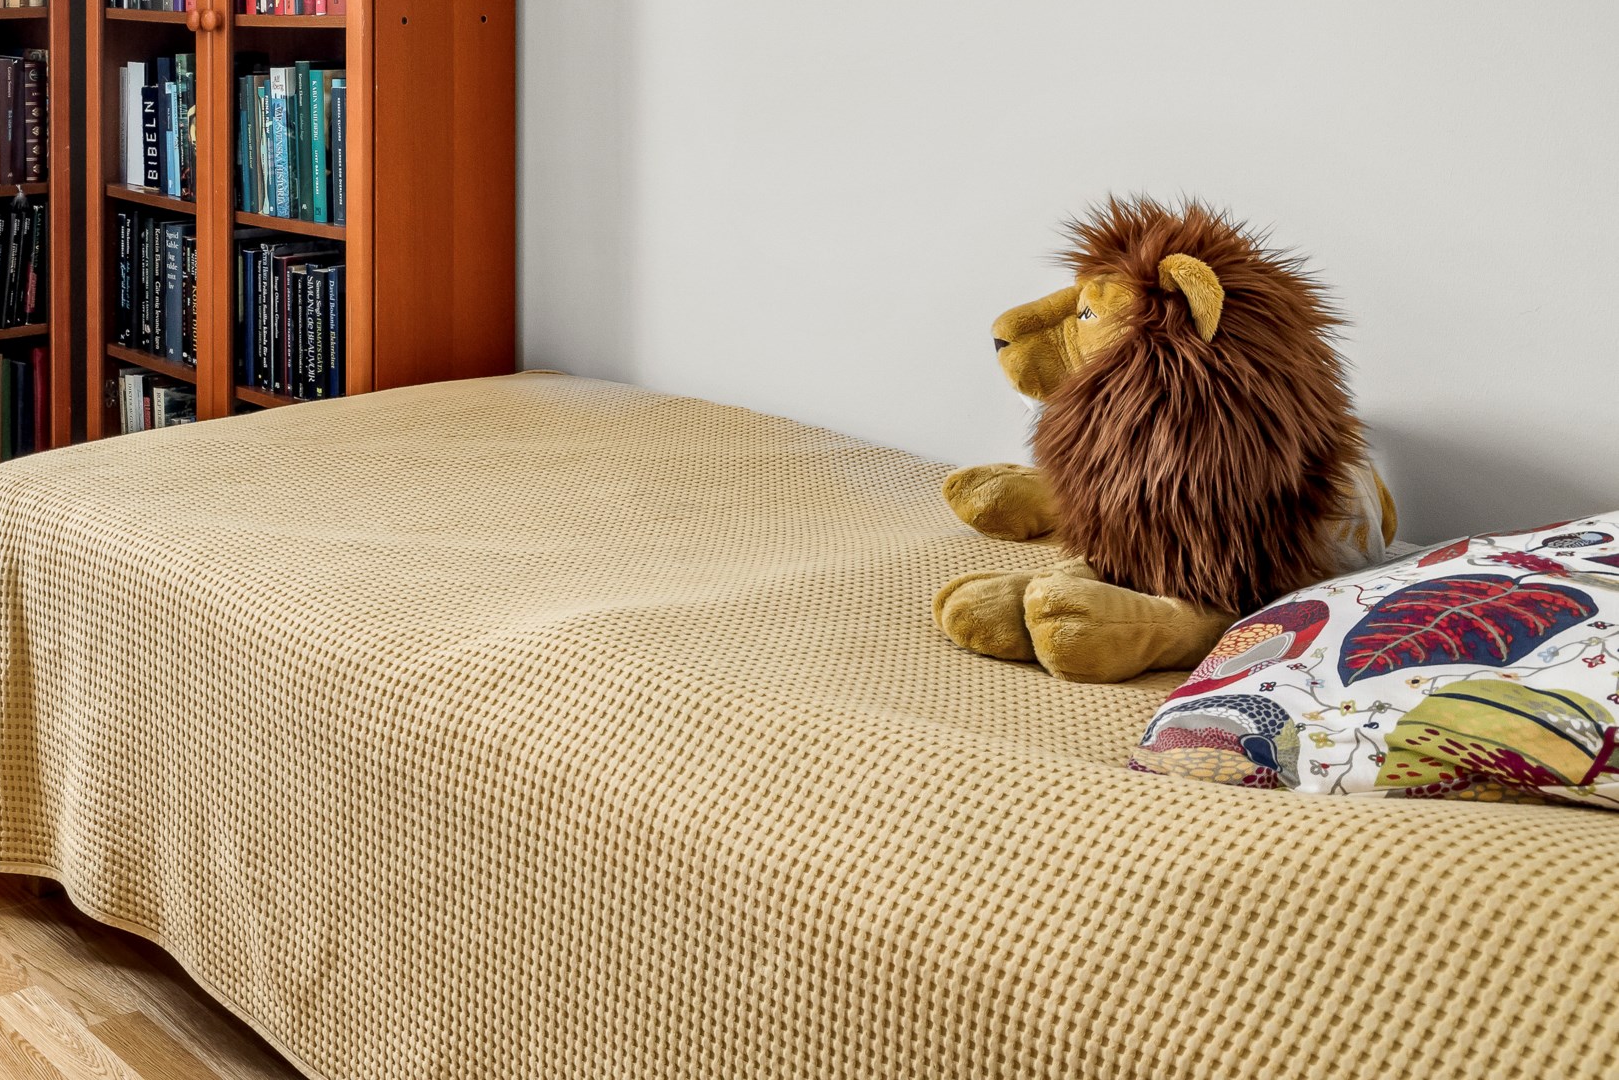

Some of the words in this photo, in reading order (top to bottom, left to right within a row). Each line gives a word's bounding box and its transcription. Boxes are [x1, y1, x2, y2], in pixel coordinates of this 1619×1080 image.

[144, 101, 158, 180] BIBELN
[275, 122, 284, 162] SVENSKA
[275, 164, 284, 206] HISTORIA
[307, 317, 314, 330] de
[307, 331, 315, 382] BEAUVOIR
